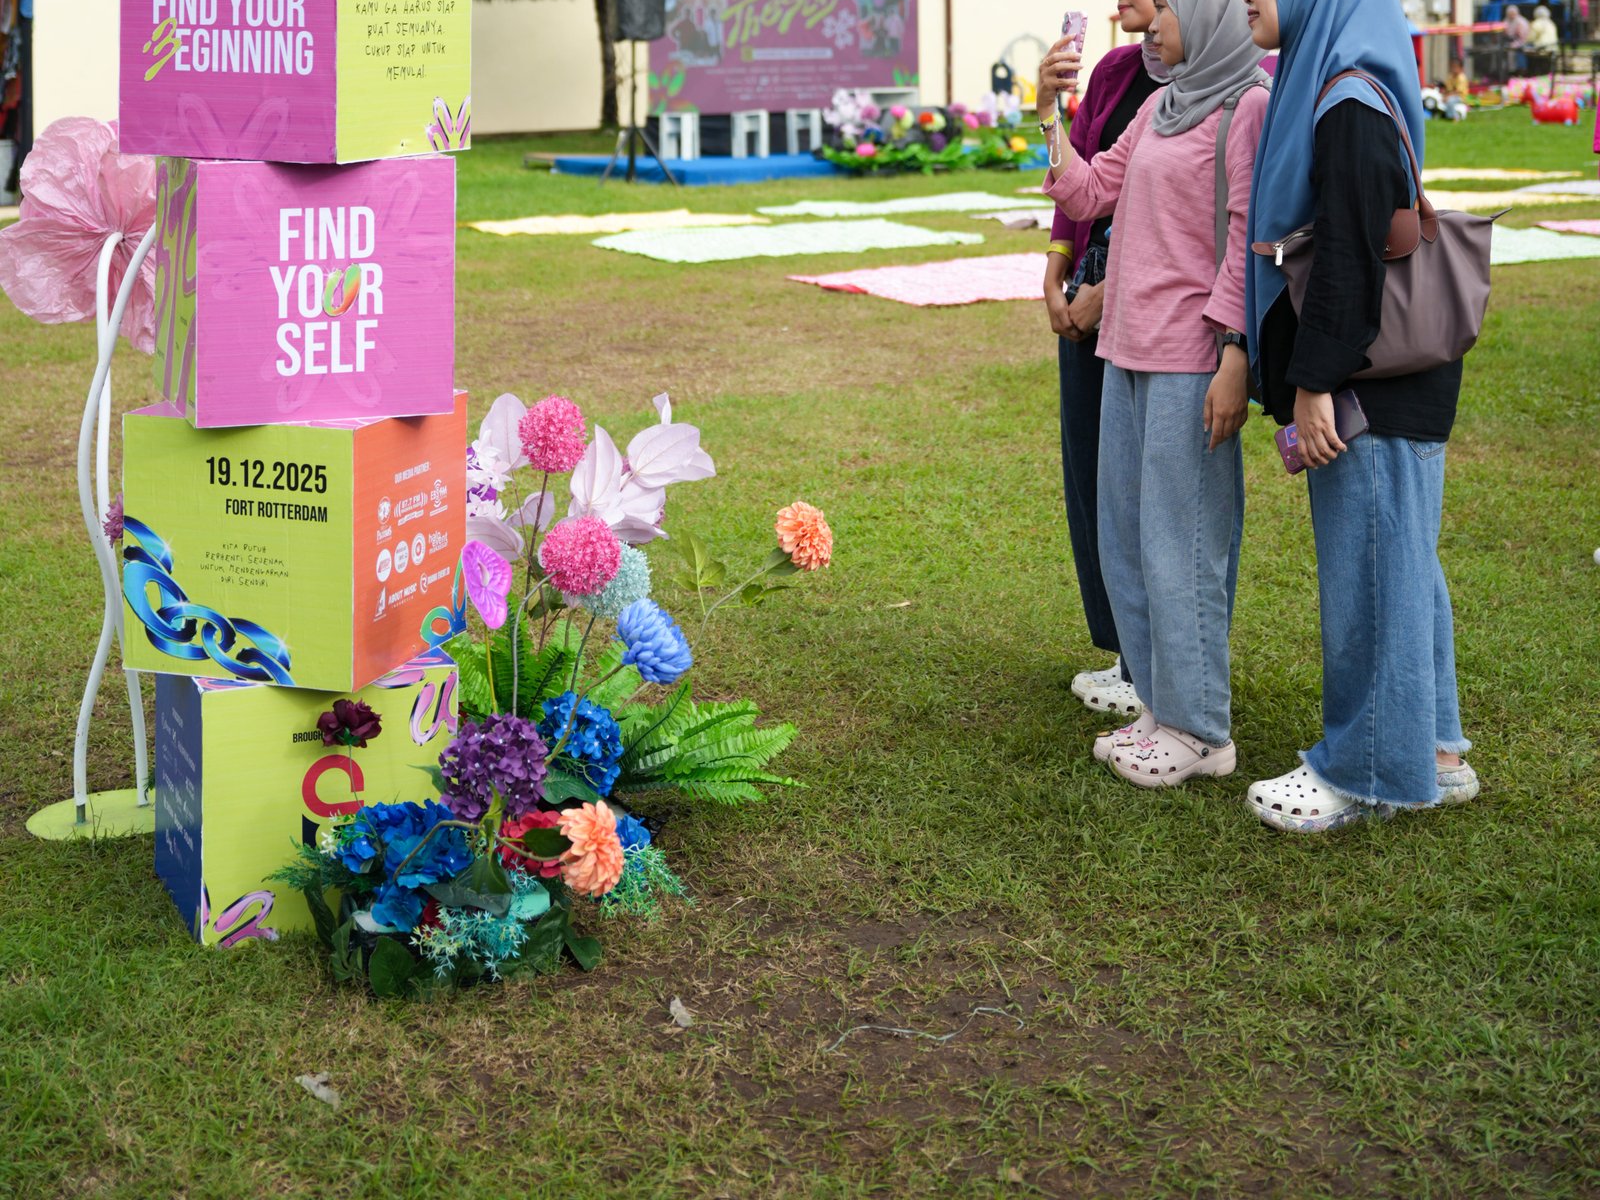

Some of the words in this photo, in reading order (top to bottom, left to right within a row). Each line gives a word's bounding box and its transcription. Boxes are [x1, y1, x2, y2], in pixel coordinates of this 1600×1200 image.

[355, 1, 379, 15] KAMU
[384, 1, 398, 15] GA
[403, 0, 432, 15] HARUS
[367, 21, 390, 39] BUAT
[142, 17, 314, 82] BEGINNING
[422, 41, 446, 54] UNTUK
[279, 206, 376, 261] FIND
[269, 262, 384, 319] YOUR
[275, 319, 379, 377] SELF
[206, 456, 328, 494] 19.12.2025
[225, 498, 255, 518] FORT
[257, 501, 328, 523] ROTTERDAM
[222, 543, 238, 551] KITA
[292, 730, 324, 744] BROUGH
